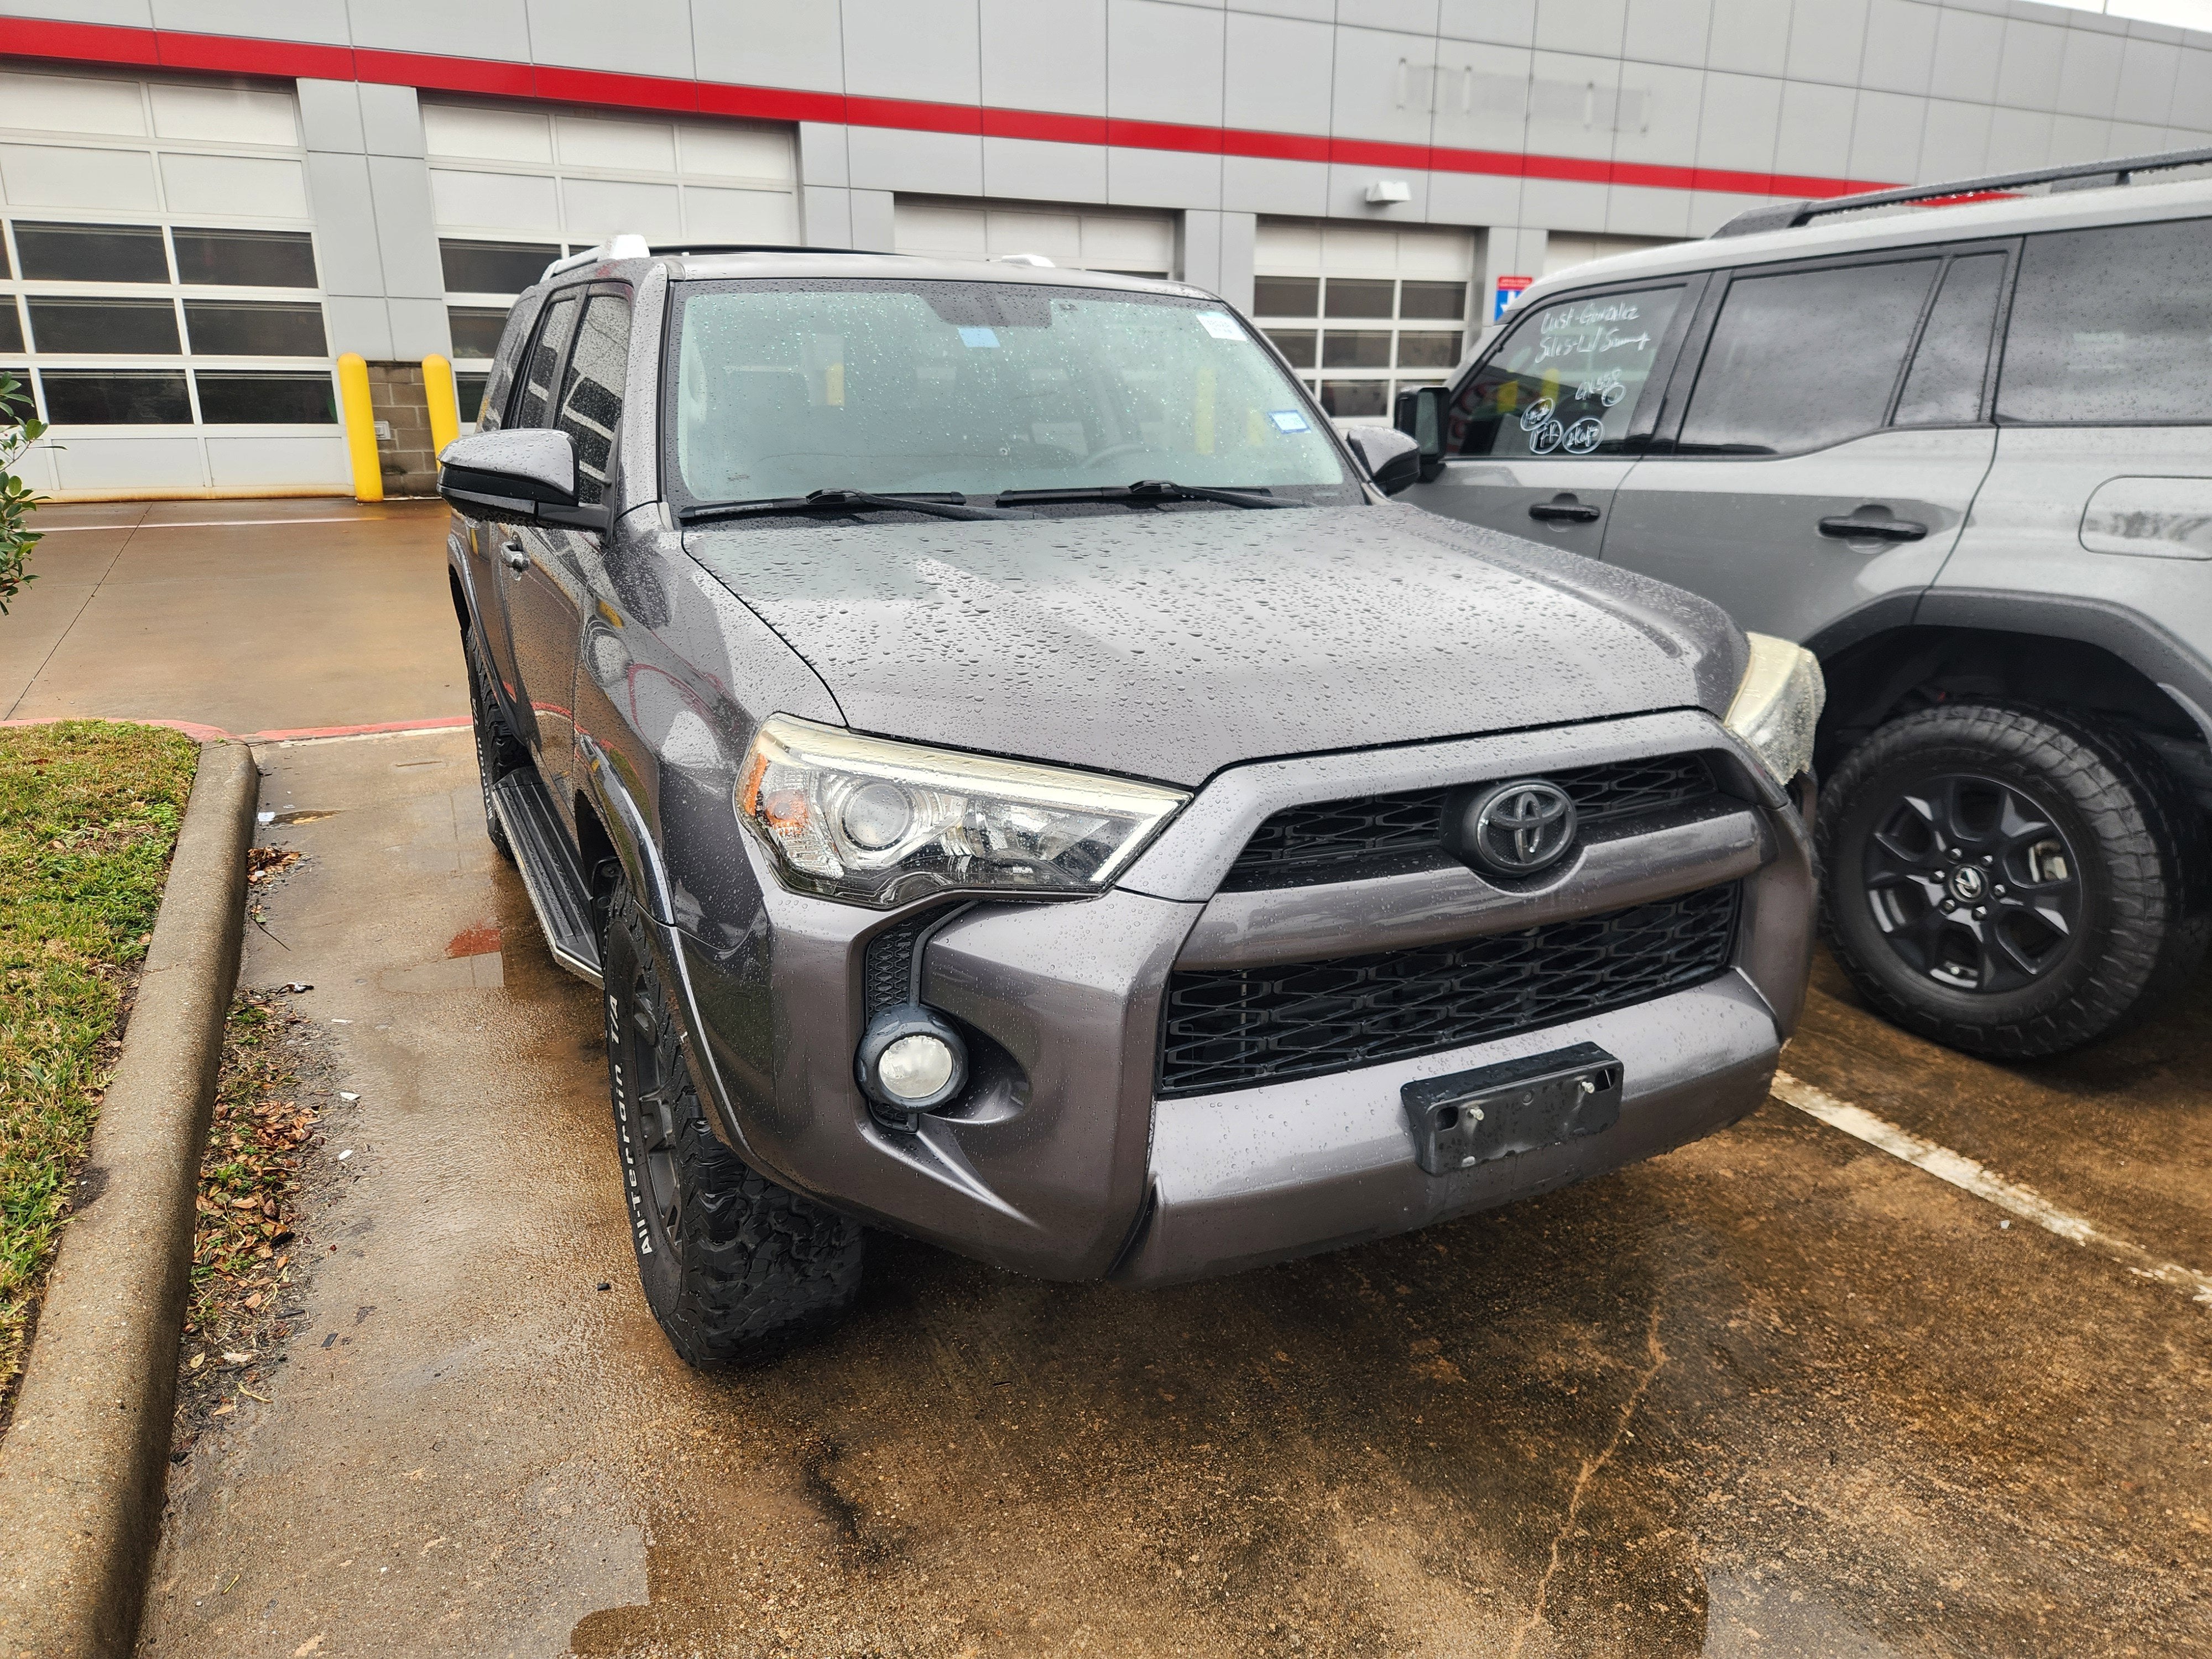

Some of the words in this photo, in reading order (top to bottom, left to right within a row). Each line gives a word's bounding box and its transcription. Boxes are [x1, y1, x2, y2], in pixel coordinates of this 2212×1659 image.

[477, 737, 493, 820] All-Terrain
[609, 994, 619, 1045] T/A
[615, 1064, 653, 1255] All-Terrain
